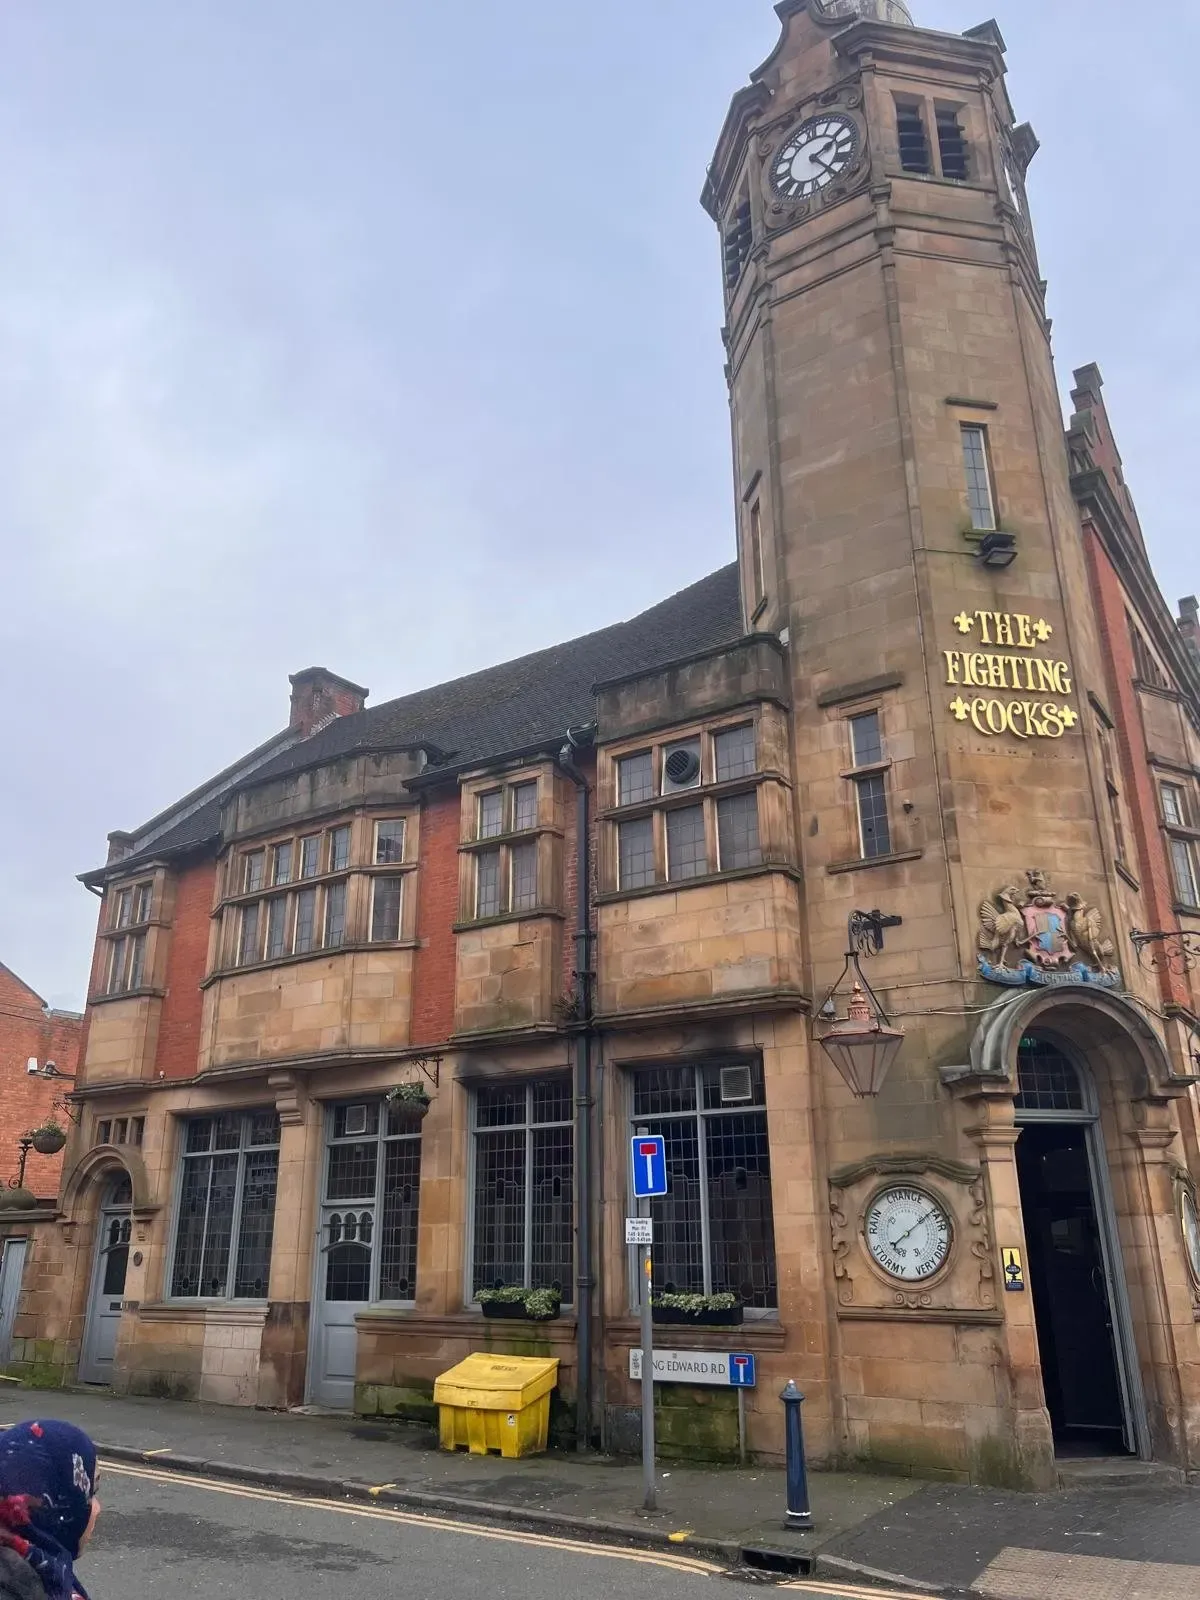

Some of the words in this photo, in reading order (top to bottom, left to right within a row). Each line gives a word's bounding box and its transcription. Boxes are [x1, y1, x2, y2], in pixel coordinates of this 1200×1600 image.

[974, 610, 1036, 648] THE
[943, 650, 1072, 694] FIGHTING
[970, 698, 1065, 738] COCKS
[886, 1191, 922, 1204] CHANGE
[869, 1208, 882, 1235] RAIN
[931, 1207, 947, 1232] FAIR
[873, 1244, 906, 1275] STORMY
[915, 1256, 937, 1275] VERY
[933, 1237, 947, 1261] DRY
[652, 1360, 664, 1371] NG
[667, 1361, 708, 1373] EDWARD
[711, 1363, 726, 1374] RD
